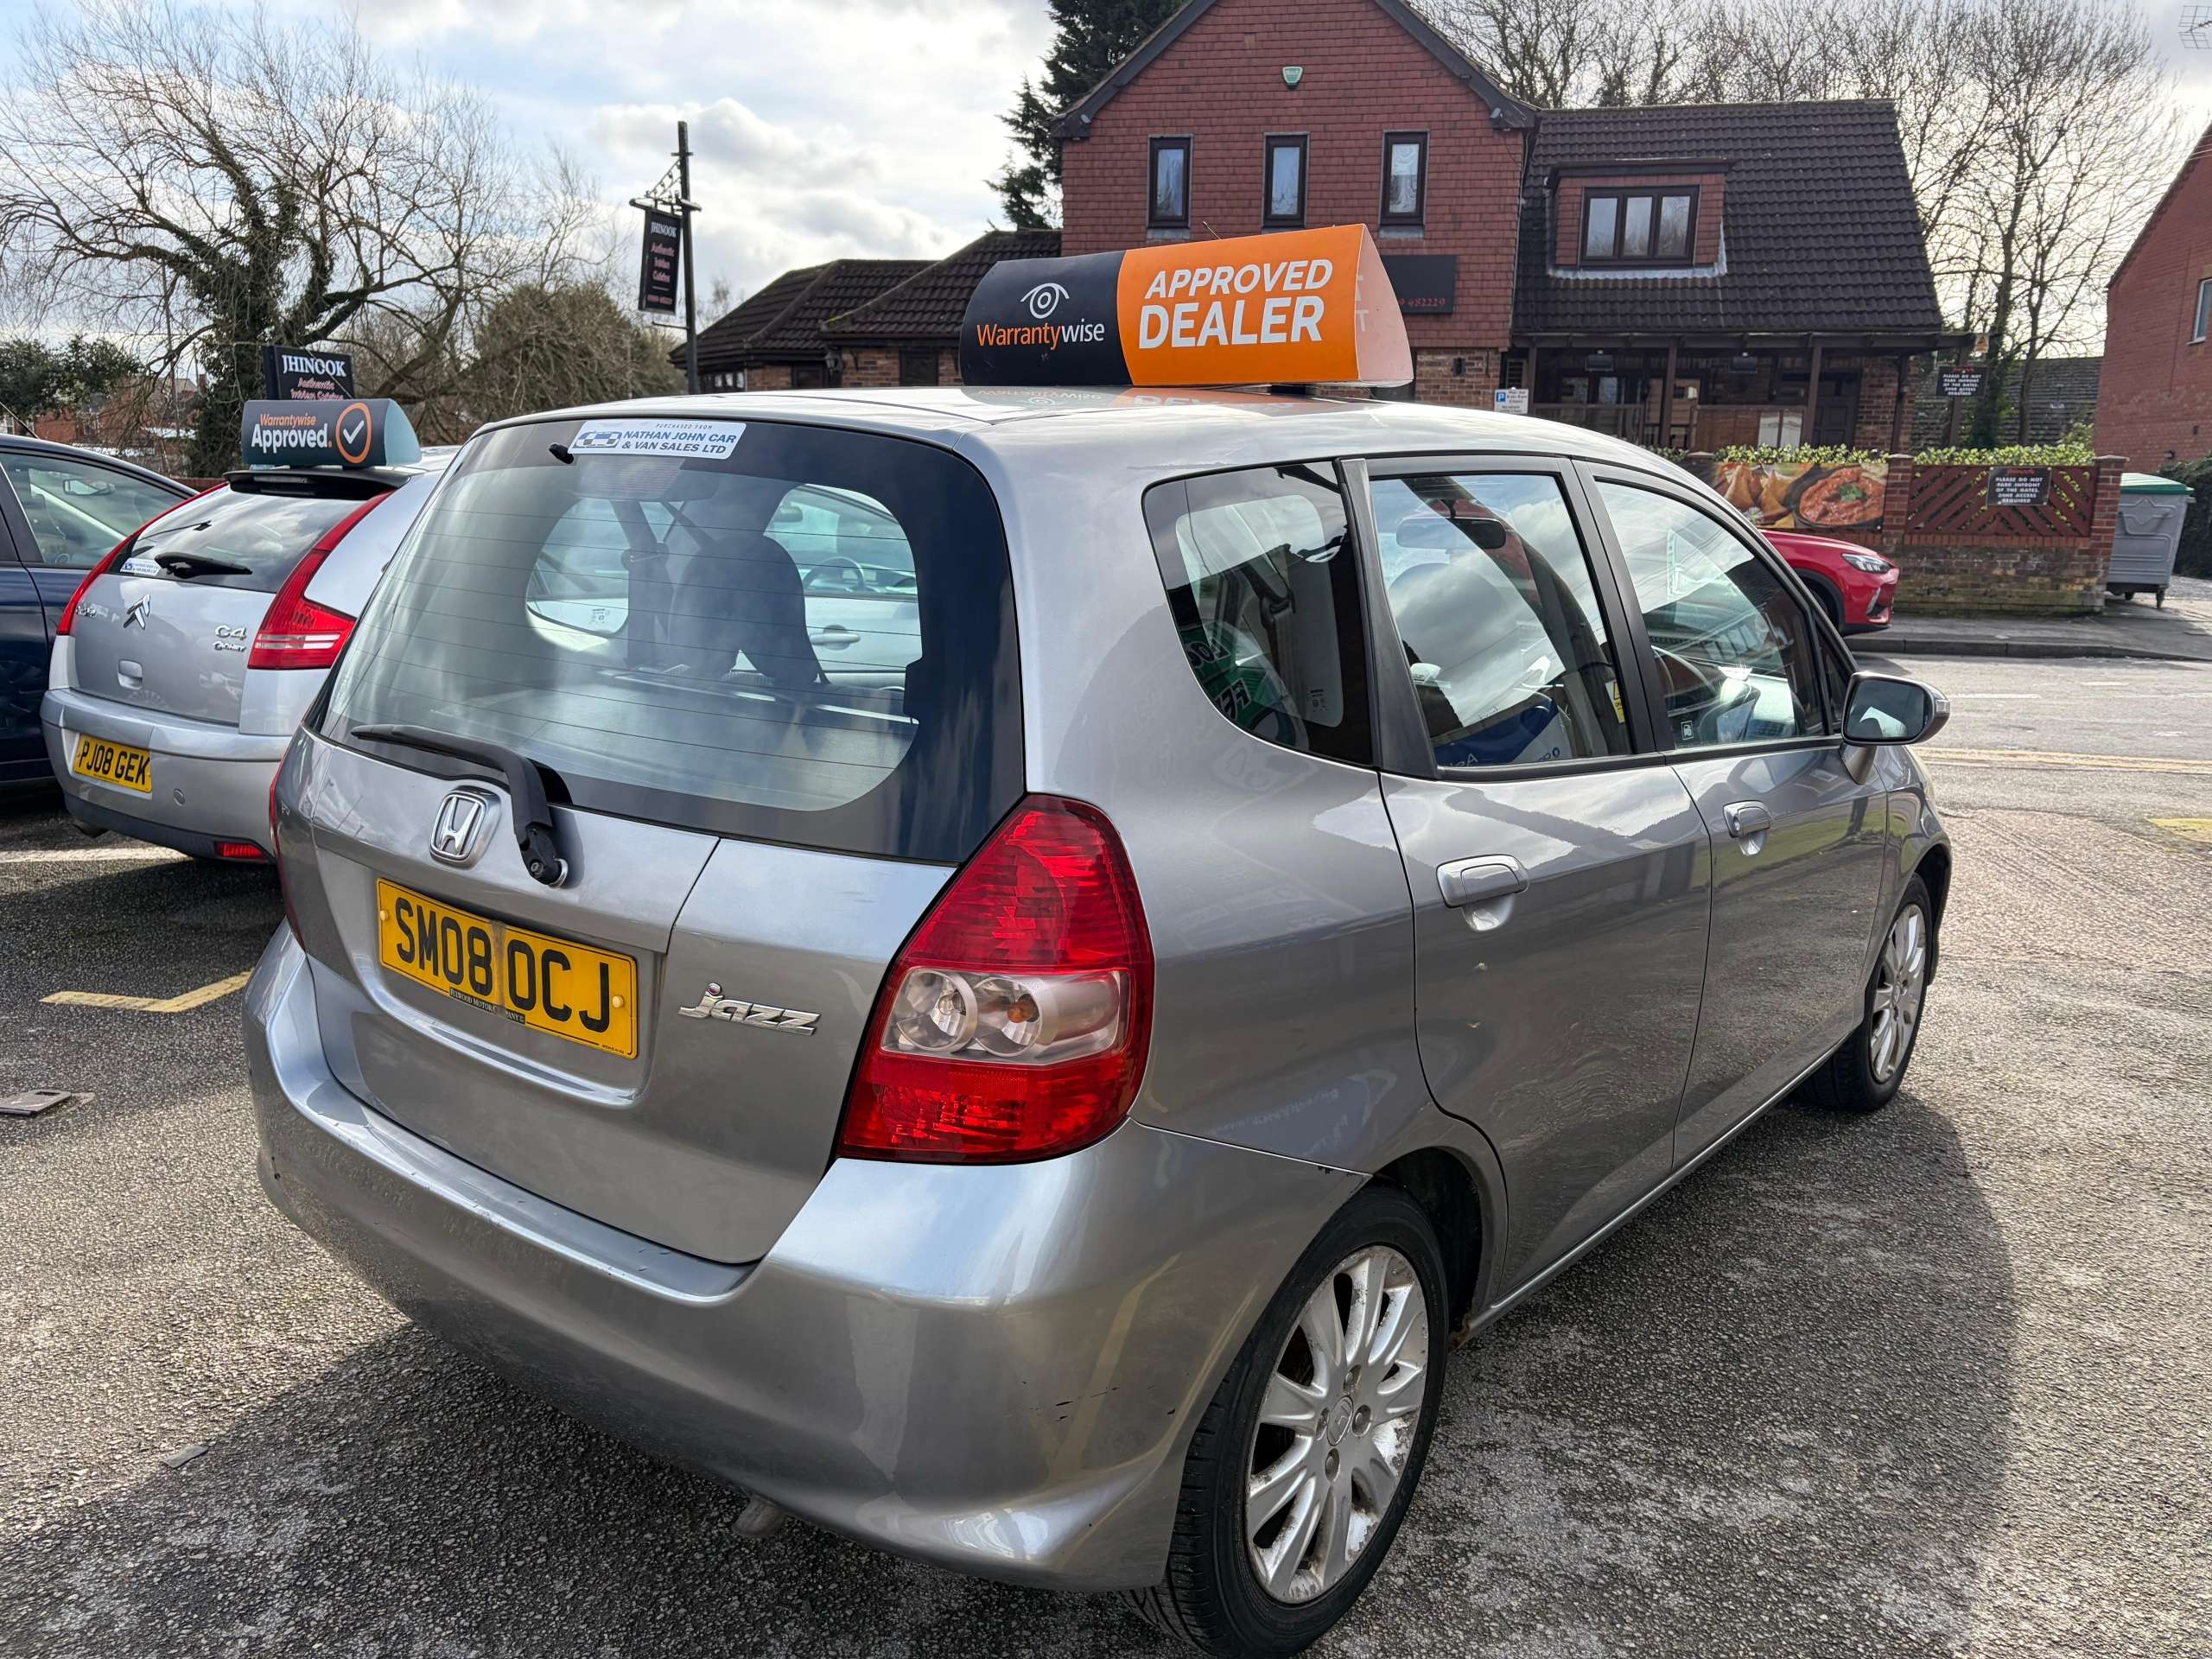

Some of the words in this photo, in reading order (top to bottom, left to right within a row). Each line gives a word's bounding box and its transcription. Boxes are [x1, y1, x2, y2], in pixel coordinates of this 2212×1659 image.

[1144, 258, 1333, 300] APPROVED
[976, 318, 1105, 351] Warrantywise
[1139, 296, 1325, 349] DEALER
[282, 354, 346, 378] JHINOOK
[260, 412, 318, 429] Warrantywise
[251, 423, 333, 454] Approved.
[621, 441, 632, 449] &
[634, 442, 659, 450] VAN
[659, 442, 700, 452] SALES
[702, 444, 727, 454] LTD
[623, 431, 671, 440] NATHAN
[671, 432, 707, 442] JOHN
[709, 434, 737, 443] CAR
[214, 624, 247, 640] C4
[78, 741, 114, 775] PJ08
[114, 750, 150, 785] GEK
[395, 897, 493, 997] SM08
[506, 939, 610, 1033] OCJ
[678, 982, 821, 1036] jazz
